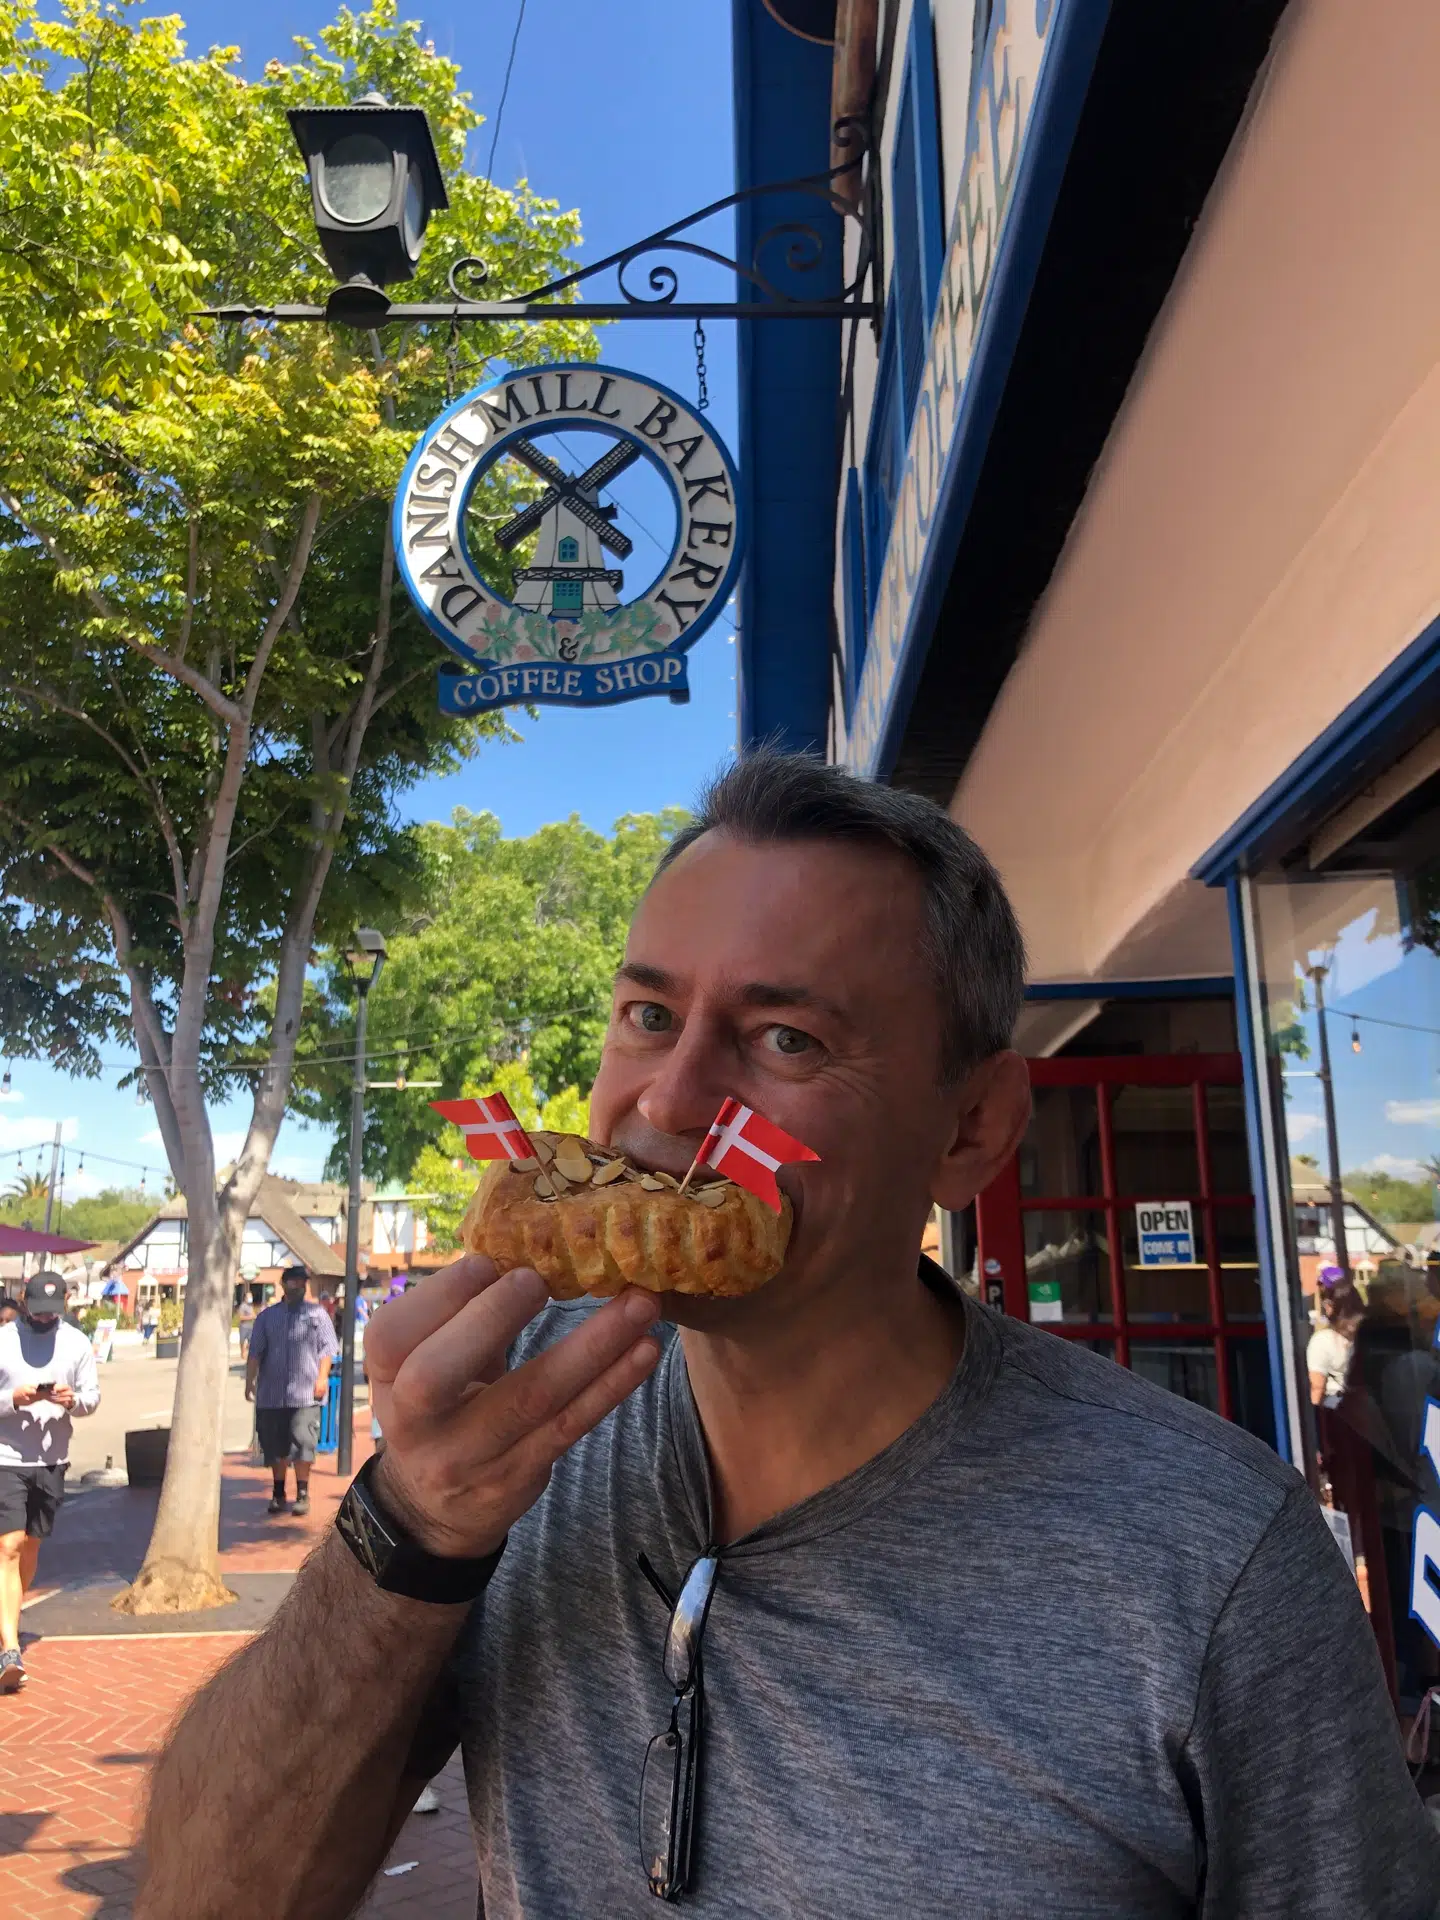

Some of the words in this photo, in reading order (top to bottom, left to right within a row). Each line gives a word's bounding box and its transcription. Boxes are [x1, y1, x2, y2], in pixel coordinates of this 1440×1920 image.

[406, 422, 487, 629] DANISH
[473, 373, 621, 435] MILL
[634, 396, 734, 631] BAKERY
[558, 637, 578, 662] &
[452, 668, 583, 707] COFFEE
[595, 658, 682, 695] SHOP
[1140, 1210, 1189, 1231] OPEN
[1143, 1241, 1177, 1255] COME
[1177, 1240, 1192, 1253] IN
